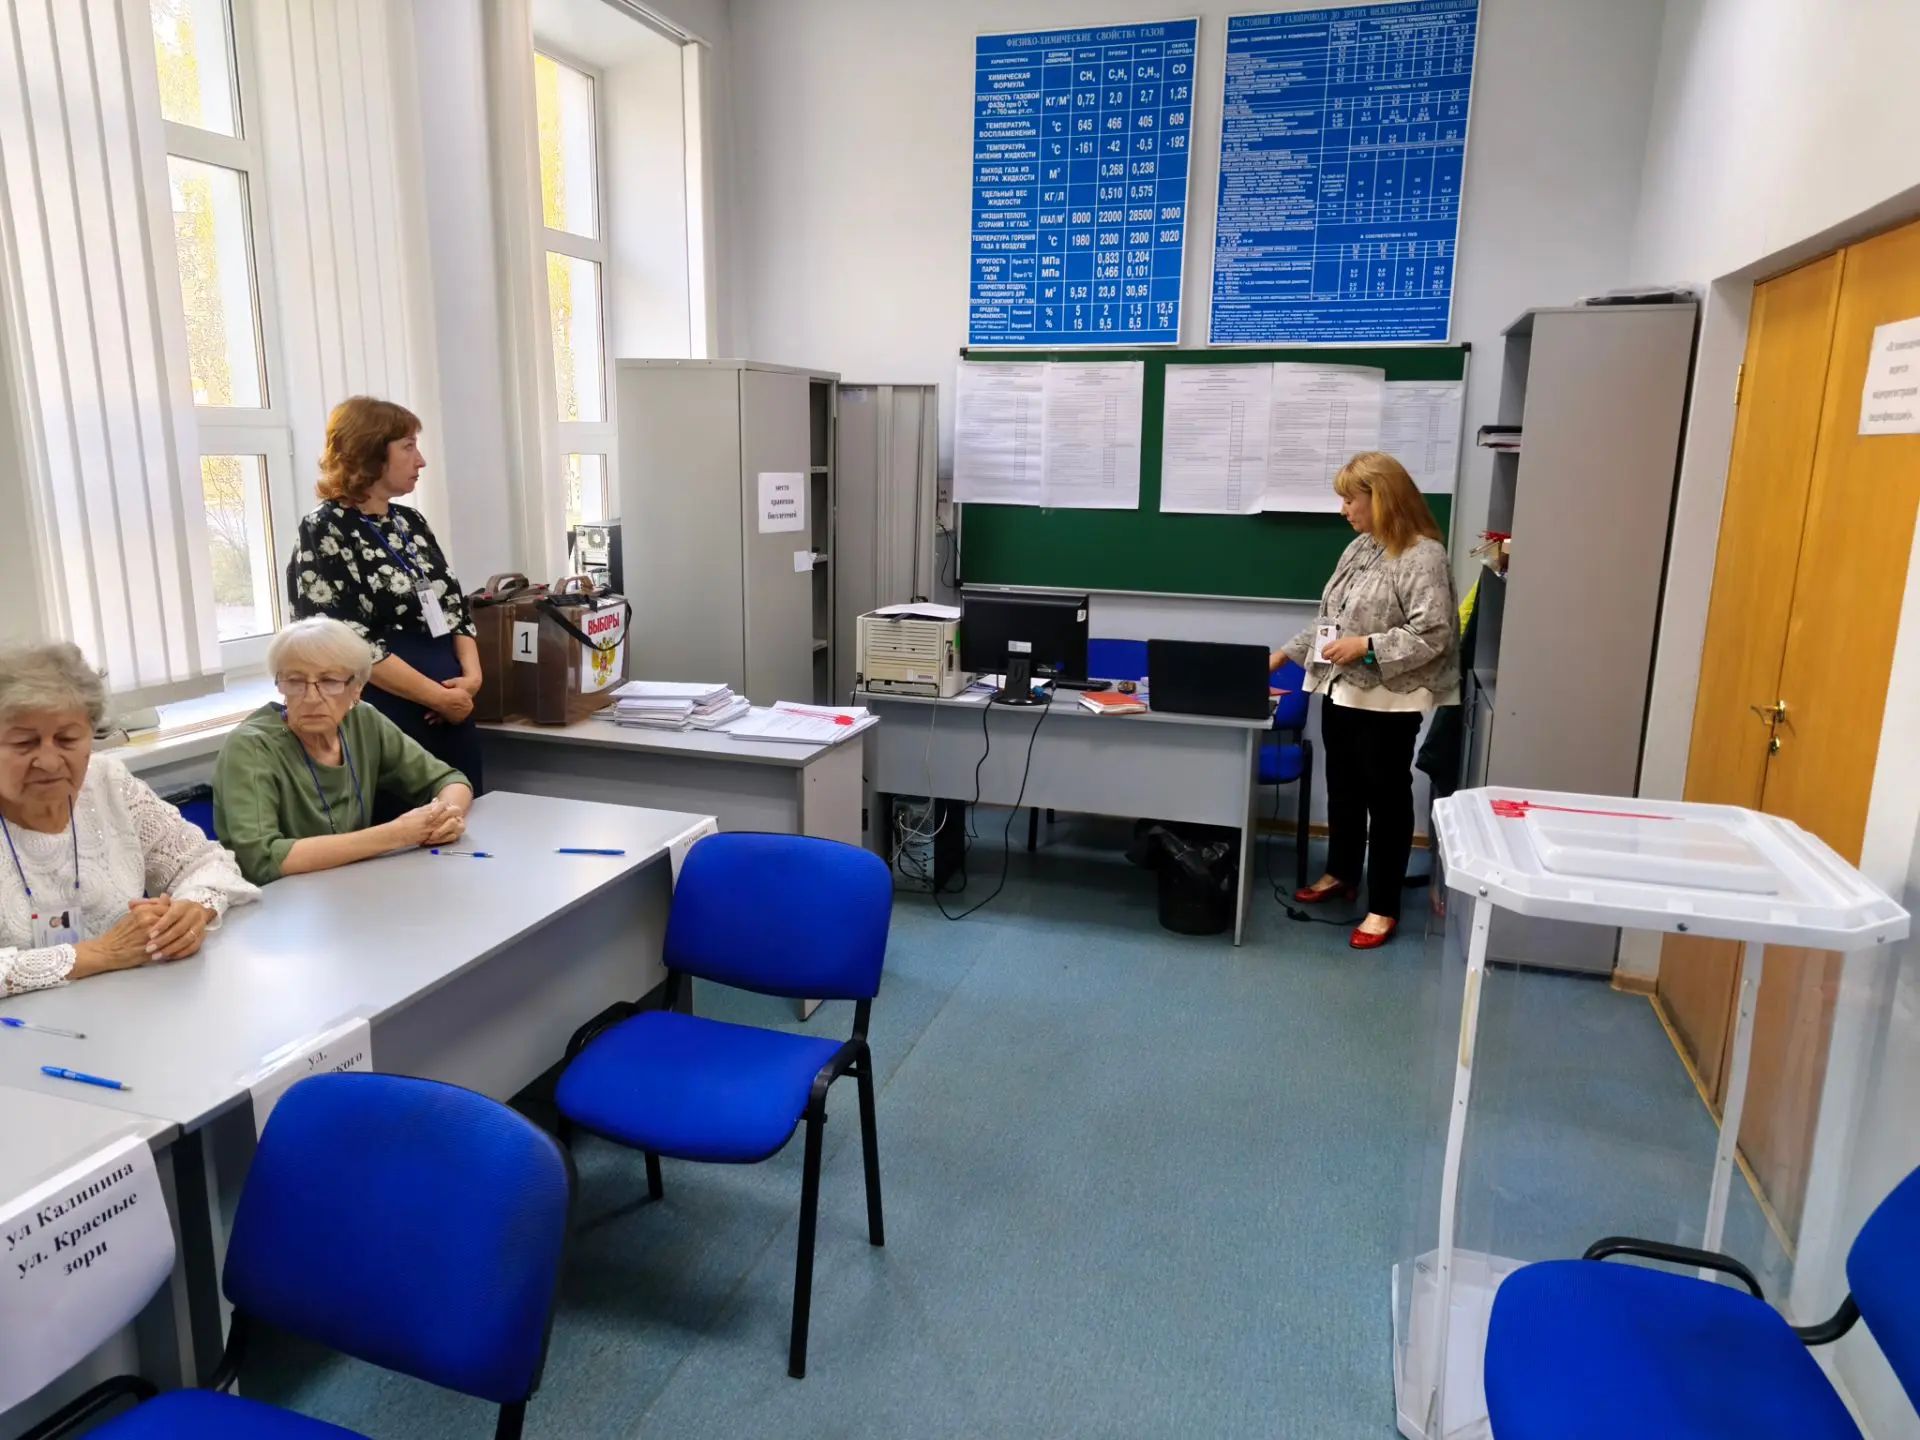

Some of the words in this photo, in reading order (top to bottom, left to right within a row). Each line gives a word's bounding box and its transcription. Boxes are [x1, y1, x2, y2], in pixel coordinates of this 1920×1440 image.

[1006, 31, 1091, 47] ФИЗИКО-ХИМИЧЕСКИЕ
[1096, 27, 1136, 41] СВОЙСТВА
[1140, 26, 1165, 39] ГАЗОВ
[988, 72, 1031, 81] ХИМИЧЕСКАЯ
[993, 81, 1025, 89] ФОРМУЛА
[977, 94, 1011, 102] ПЛОТНОСТЬ
[1013, 92, 1040, 100] ГАЗОВОЙ
[1109, 91, 1123, 106] 2,0
[1140, 89, 1154, 103] 2,7
[1170, 86, 1187, 101] 1,25
[1077, 93, 1095, 107] 0,72
[985, 121, 1030, 129] ТЕМПЕРАТУРА
[1077, 119, 1093, 131] 645
[1107, 117, 1122, 130] 466
[1138, 115, 1153, 128] 405
[1169, 113, 1185, 126] 609
[979, 129, 1036, 138] ВОСПЛАМЕНЕНИЯ
[986, 143, 1026, 151] ТЕМПЕРАТУРА
[1075, 142, 1093, 153] -161
[1107, 140, 1120, 152] -42
[1136, 138, 1153, 152] -0,5
[1166, 136, 1185, 148] -192
[1004, 151, 1036, 159] ЖИДКОСТИ
[981, 167, 1002, 175] ВЫХОД
[1005, 166, 1019, 174] ГАЗА
[1101, 163, 1123, 178] 0,268
[1132, 161, 1155, 176] 0,238
[1002, 174, 1035, 182] ЖИДКОСТИ
[981, 189, 1014, 198] УДЕЛЬНЫЙ
[1044, 191, 1064, 202] КГ/Л
[1100, 187, 1123, 201] 0,510
[1131, 185, 1153, 200] 0,575
[988, 198, 1021, 206] ЖИДКОСТИ
[1072, 212, 1091, 224] 8000
[1099, 210, 1122, 223] 22000
[1129, 209, 1153, 221] 28500
[1161, 207, 1181, 219] 3000
[972, 234, 1009, 242] ТЕМПЕРАТУРА
[1011, 233, 1036, 241] ГОРЕНИЯ
[1072, 234, 1090, 246] 1980
[1100, 233, 1119, 245] 2300
[1130, 232, 1149, 244] 2300
[1160, 230, 1179, 243] 3020
[1001, 242, 1027, 250] ВОЗДУХЕ
[1042, 256, 1060, 265] МПа
[1097, 252, 1119, 265] 0,833
[1127, 251, 1149, 264] 0,204
[1041, 268, 1059, 277] МПа
[1097, 267, 1118, 279] 0,466
[1126, 265, 1148, 279] 0,101
[1070, 286, 1087, 300] 9,52
[1098, 285, 1115, 299] 23,8
[1126, 284, 1148, 298] 30,95
[1045, 307, 1053, 316] %
[1075, 306, 1081, 316] 5
[1103, 304, 1109, 315] 2
[1130, 303, 1142, 316] 1,5
[1156, 302, 1173, 315] 12,5
[1045, 319, 1053, 328] %
[1073, 318, 1082, 329] 15
[1099, 317, 1111, 331] 9,5
[1129, 317, 1141, 330] 8,5
[1159, 316, 1168, 328] 75
[588, 612, 620, 636] ВЫБОРЫ
[520, 631, 532, 654] 1
[308, 1051, 328, 1071] ул.
[6, 1224, 32, 1251] ул
[36, 1163, 134, 1228] Калинина
[17, 1252, 48, 1280] ул.
[53, 1193, 138, 1252] Красные
[64, 1241, 108, 1276] зори
